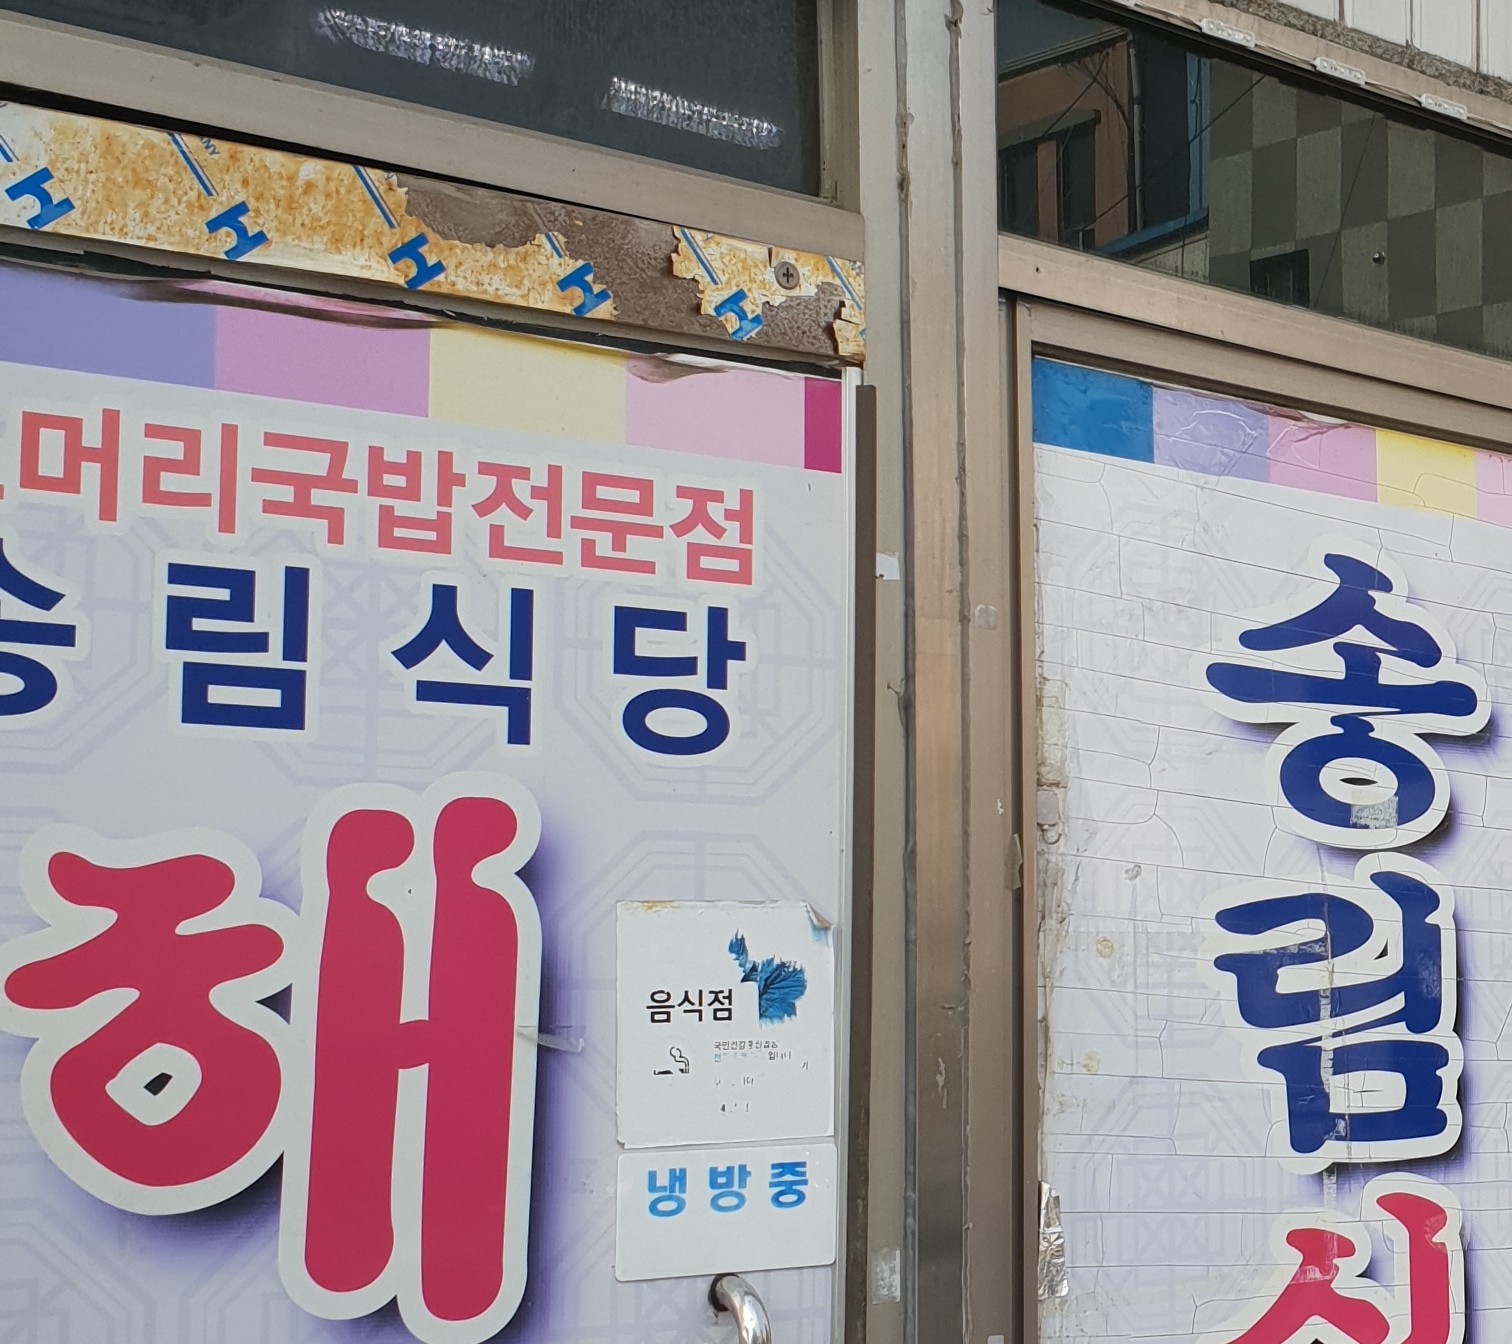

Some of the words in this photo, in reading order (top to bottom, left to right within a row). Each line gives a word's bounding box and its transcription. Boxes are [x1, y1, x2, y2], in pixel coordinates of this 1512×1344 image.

[0, 408, 755, 587] 머리국밥전문점
[646, 988, 733, 1024] 음식점
[648, 1160, 809, 1218] 냉방중
